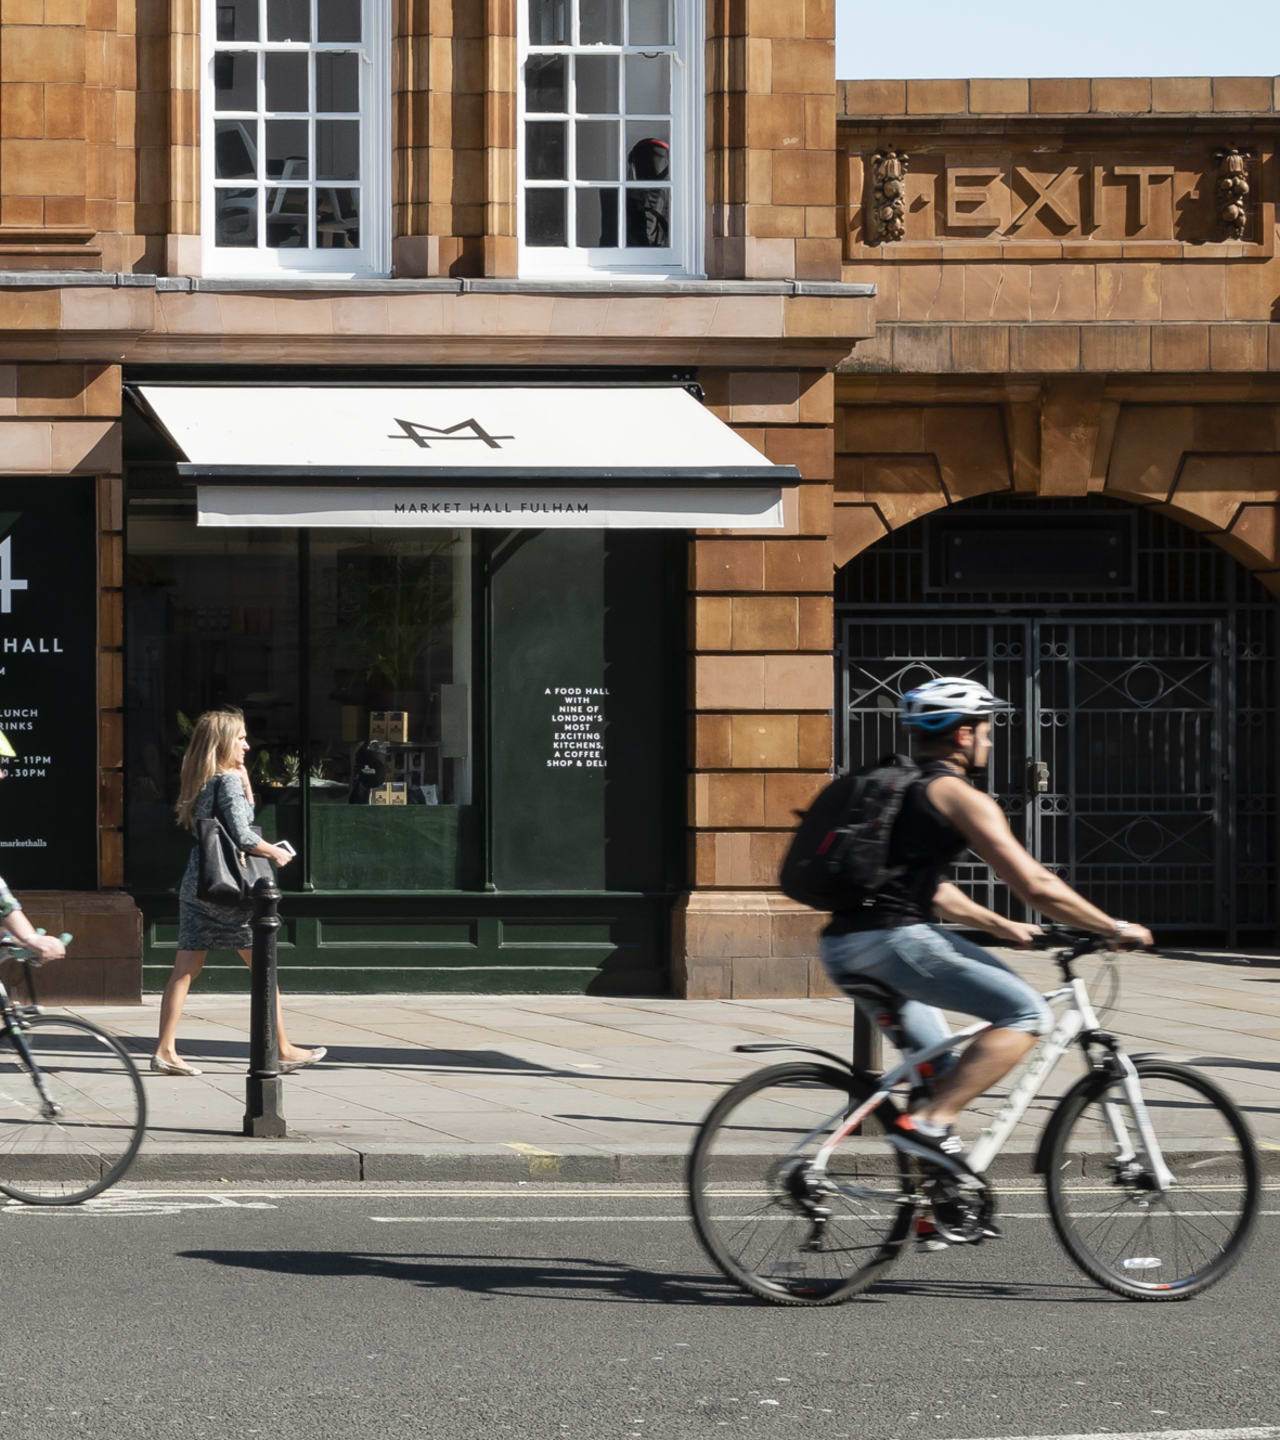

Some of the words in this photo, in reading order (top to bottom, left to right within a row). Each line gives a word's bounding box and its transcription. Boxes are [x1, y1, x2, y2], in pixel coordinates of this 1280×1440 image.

[947, 165, 1175, 228] EXIT
[394, 502, 462, 513] MARKET
[469, 502, 512, 513] HALL
[520, 502, 590, 513] FULHAM
[3, 637, 64, 653] HALL
[544, 687, 551, 695] A
[555, 687, 582, 695] FOOD
[585, 687, 610, 695] HALL
[565, 696, 590, 704] WITH
[559, 705, 583, 713] NINE
[586, 705, 599, 713] OF
[564, 723, 590, 731] MOST
[554, 732, 600, 740] EXCITING
[553, 741, 604, 750] KITCHENS,
[554, 750, 561, 758] A
[564, 750, 600, 758] COFFEE
[23, 755, 52, 765] 11PM
[547, 759, 573, 767] SHOP
[576, 759, 583, 767] &
[586, 759, 608, 767] DELI
[3, 768, 46, 778] 0.30PM
